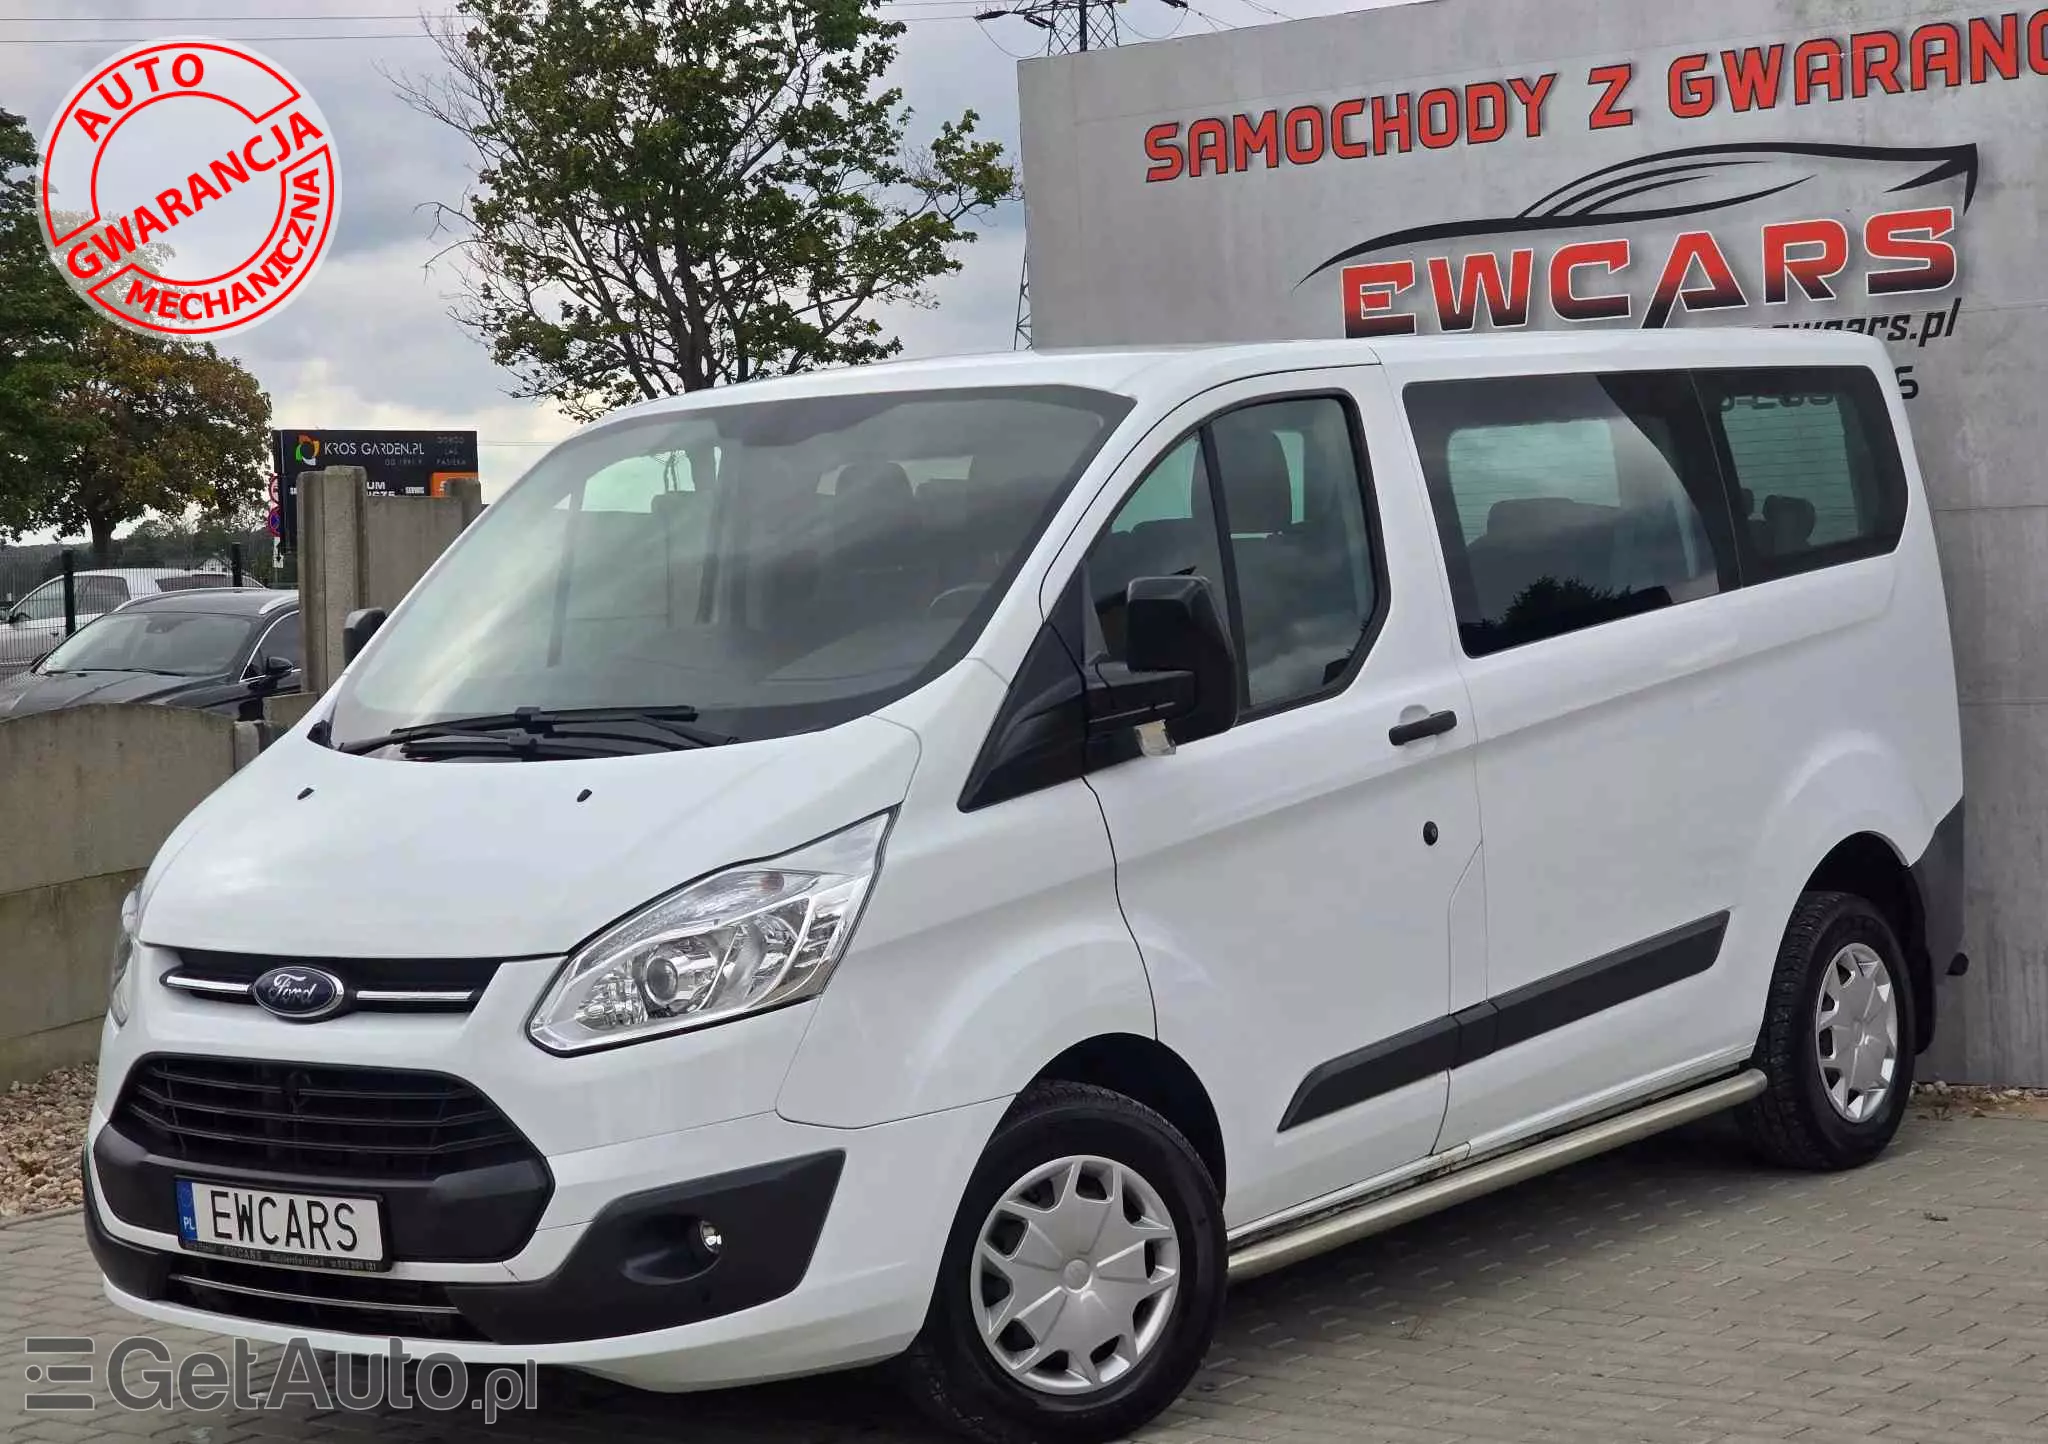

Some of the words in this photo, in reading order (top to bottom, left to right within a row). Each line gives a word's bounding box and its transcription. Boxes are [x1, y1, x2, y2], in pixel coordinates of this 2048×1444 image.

[1145, 73, 1557, 182] SAMOCHODY
[1589, 63, 1634, 130] Z
[1341, 207, 1958, 340] EWCARS
[324, 442, 357, 455] KROS
[361, 441, 424, 455] GARDEN.PL
[268, 973, 317, 1004] Ford
[183, 1216, 196, 1231] PL
[210, 1190, 357, 1251] EWCARS
